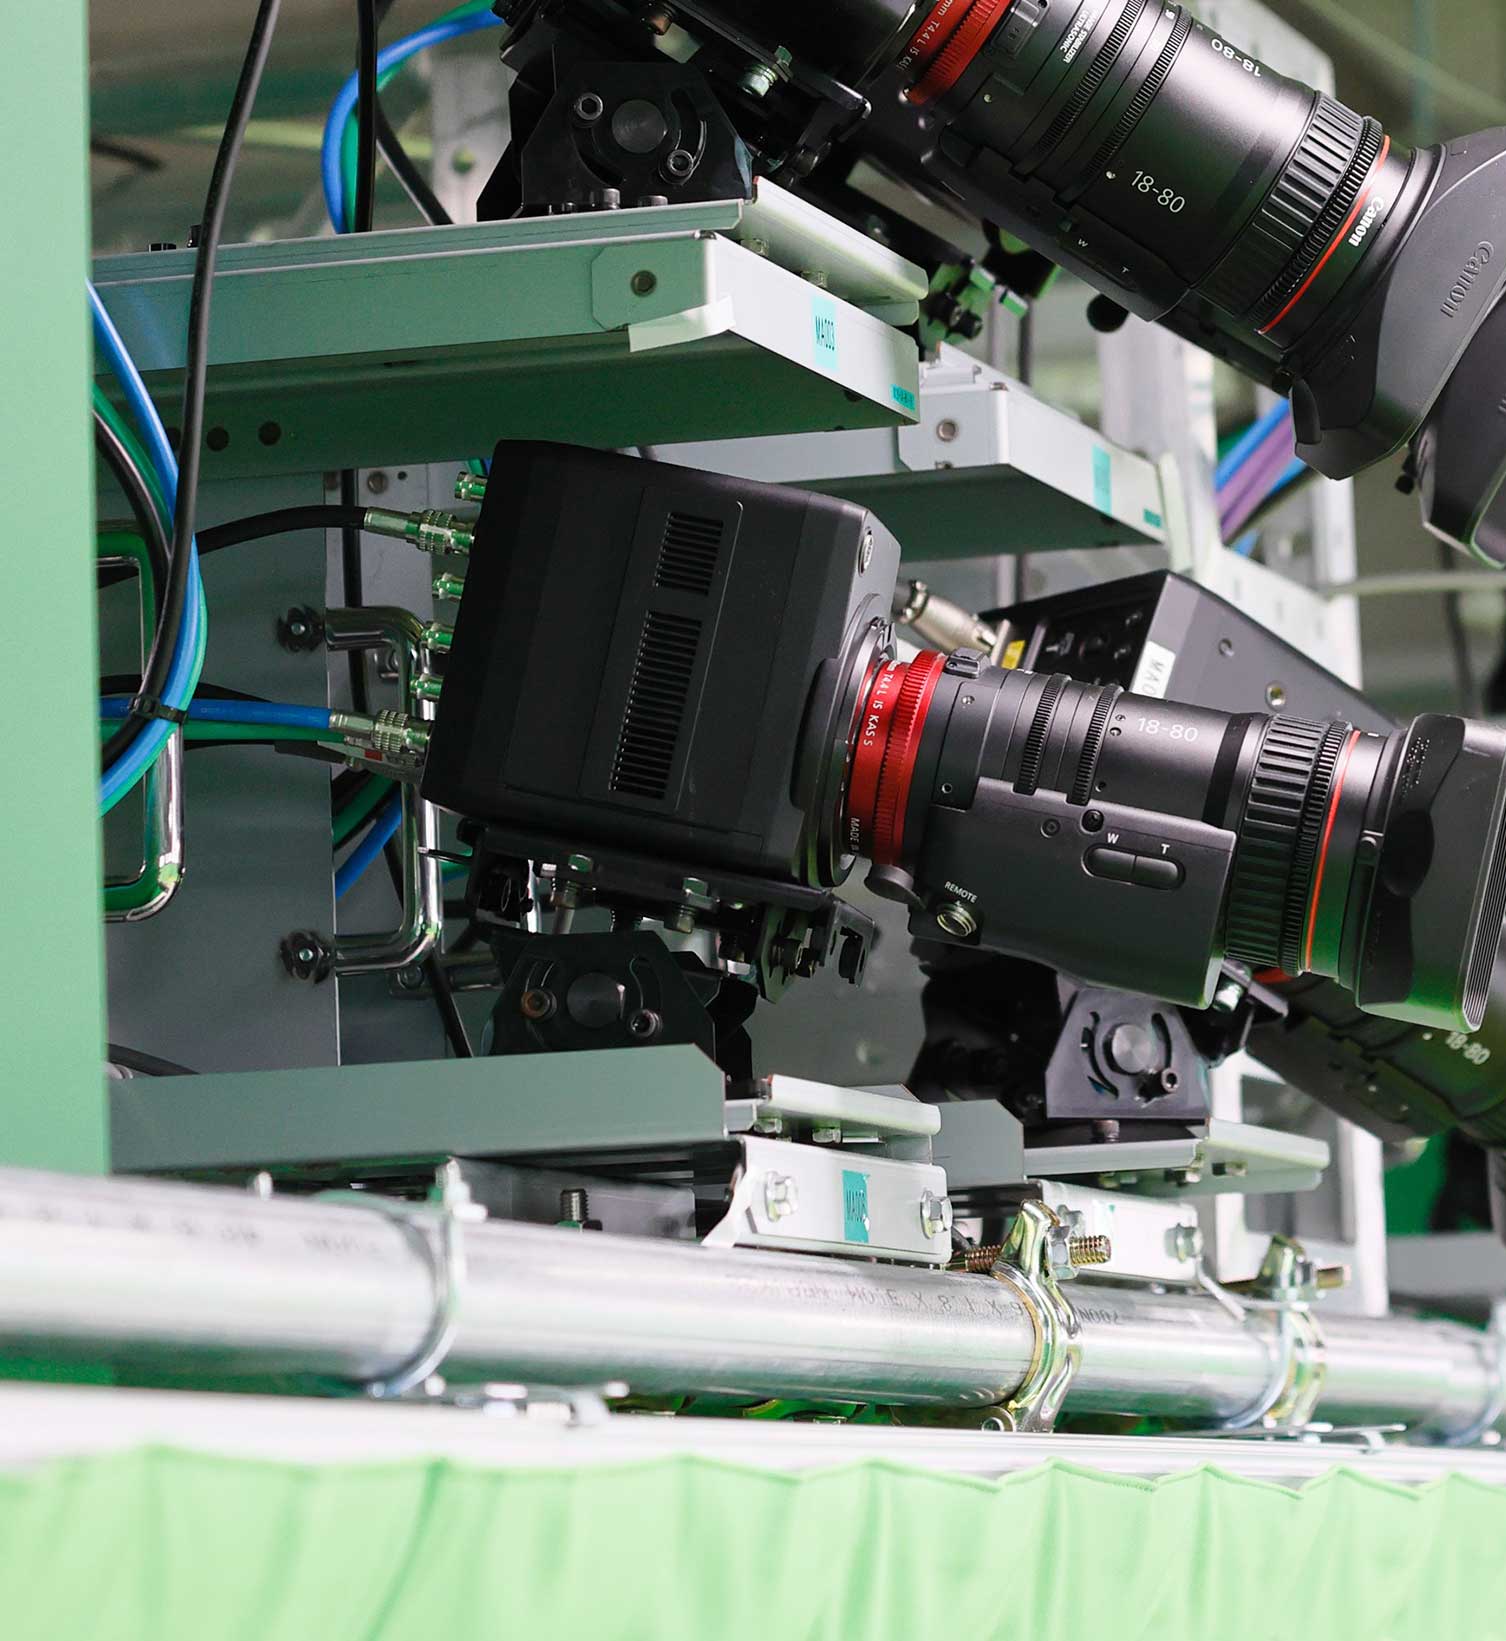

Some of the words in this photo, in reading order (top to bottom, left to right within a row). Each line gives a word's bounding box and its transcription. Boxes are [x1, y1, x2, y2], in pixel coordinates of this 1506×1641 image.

[1211, 37, 1263, 77] 18-80
[1130, 170, 1186, 214] 18-80
[1348, 196, 1385, 247] Canon
[1439, 240, 1495, 319] Canon
[865, 714, 880, 737] KAS
[1136, 717, 1200, 743] 18-80
[1107, 833, 1120, 845] W
[1161, 843, 1171, 855] T
[944, 880, 978, 904] REMOTE
